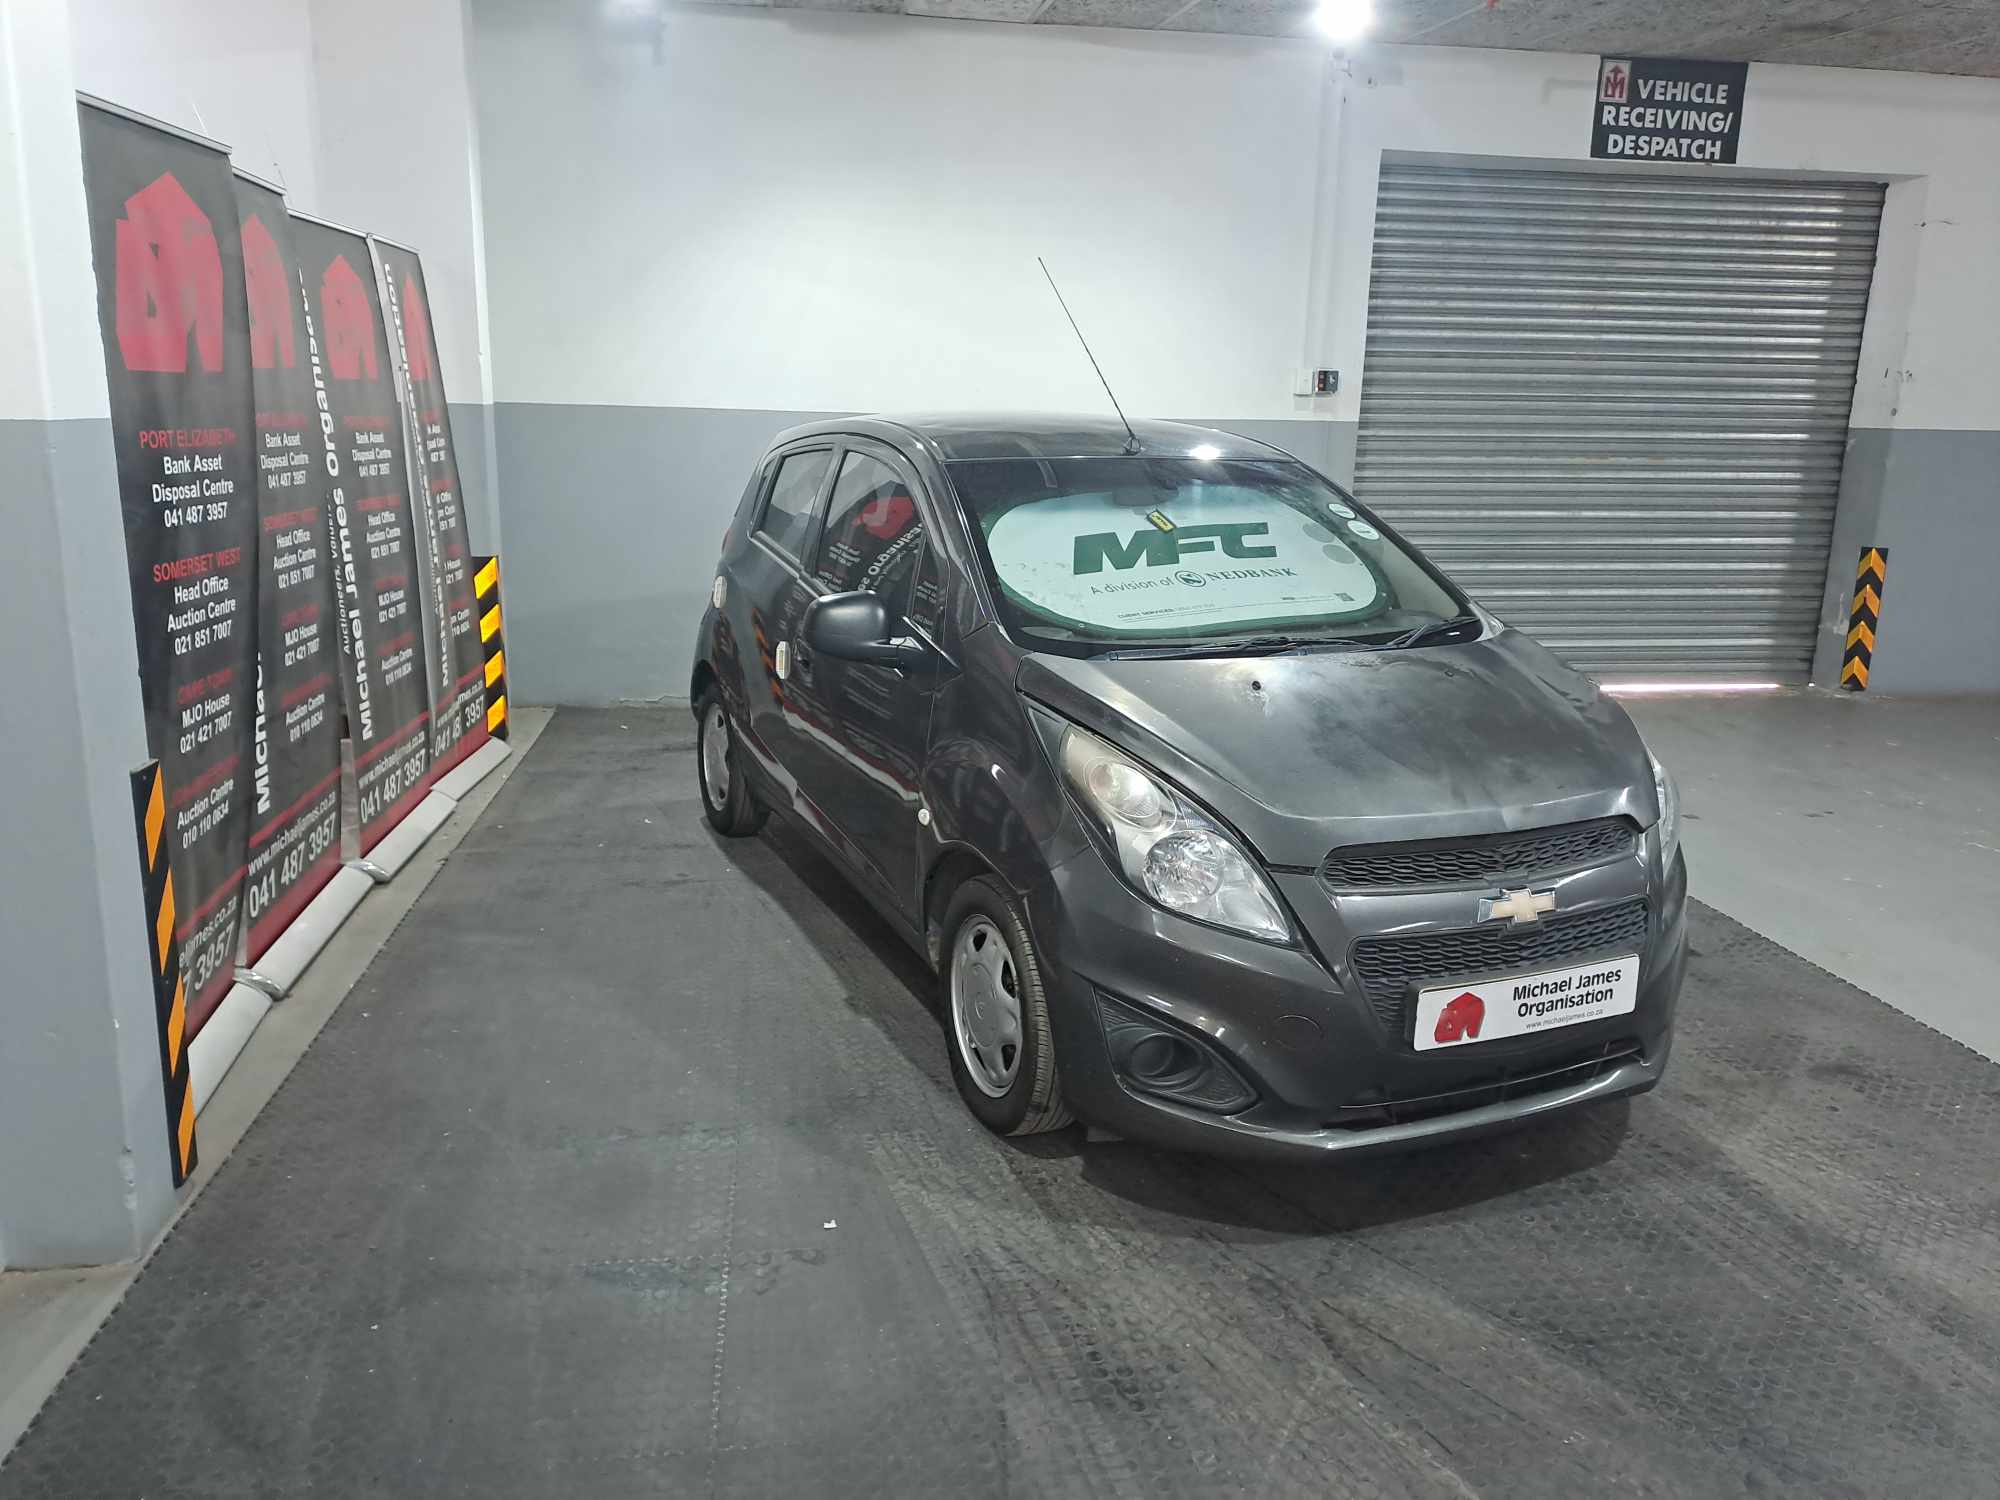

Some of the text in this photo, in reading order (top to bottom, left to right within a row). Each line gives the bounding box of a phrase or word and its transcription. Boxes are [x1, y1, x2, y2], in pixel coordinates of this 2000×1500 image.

[1637, 79, 1729, 105] VEHICLE
[1601, 105, 1734, 133] RECEIVING/
[1607, 133, 1721, 160] DESPATCH
[139, 430, 176, 449] PORT
[265, 432, 282, 449] Bank
[163, 453, 223, 475] Bank Asset
[152, 478, 234, 505] Disposal Centre
[164, 501, 228, 528] 041 487 3957
[333, 486, 358, 600] James
[1073, 522, 1278, 575] MFC
[153, 553, 214, 583] SOMERSET
[1104, 576, 1157, 594] division
[1159, 572, 1178, 588] of
[1206, 567, 1298, 582] NEDBANK
[174, 576, 229, 605] Head Office
[168, 598, 236, 633] Auction Centre
[174, 619, 232, 656] 021 851 7007
[348, 608, 373, 741] Michael
[182, 693, 230, 729] MJO House
[465, 694, 484, 728] 3957
[180, 731, 196, 754] 021
[197, 722, 212, 743] 421
[254, 651, 271, 815] Micha
[360, 748, 426, 824] 041 487 3957
[177, 797, 209, 831] Auction
[182, 825, 198, 850] 010
[249, 811, 337, 918] 041 487 3957
[195, 919, 235, 991] 3957
[1513, 969, 1622, 1001] Michael James
[1517, 987, 1614, 1018] Organisation
